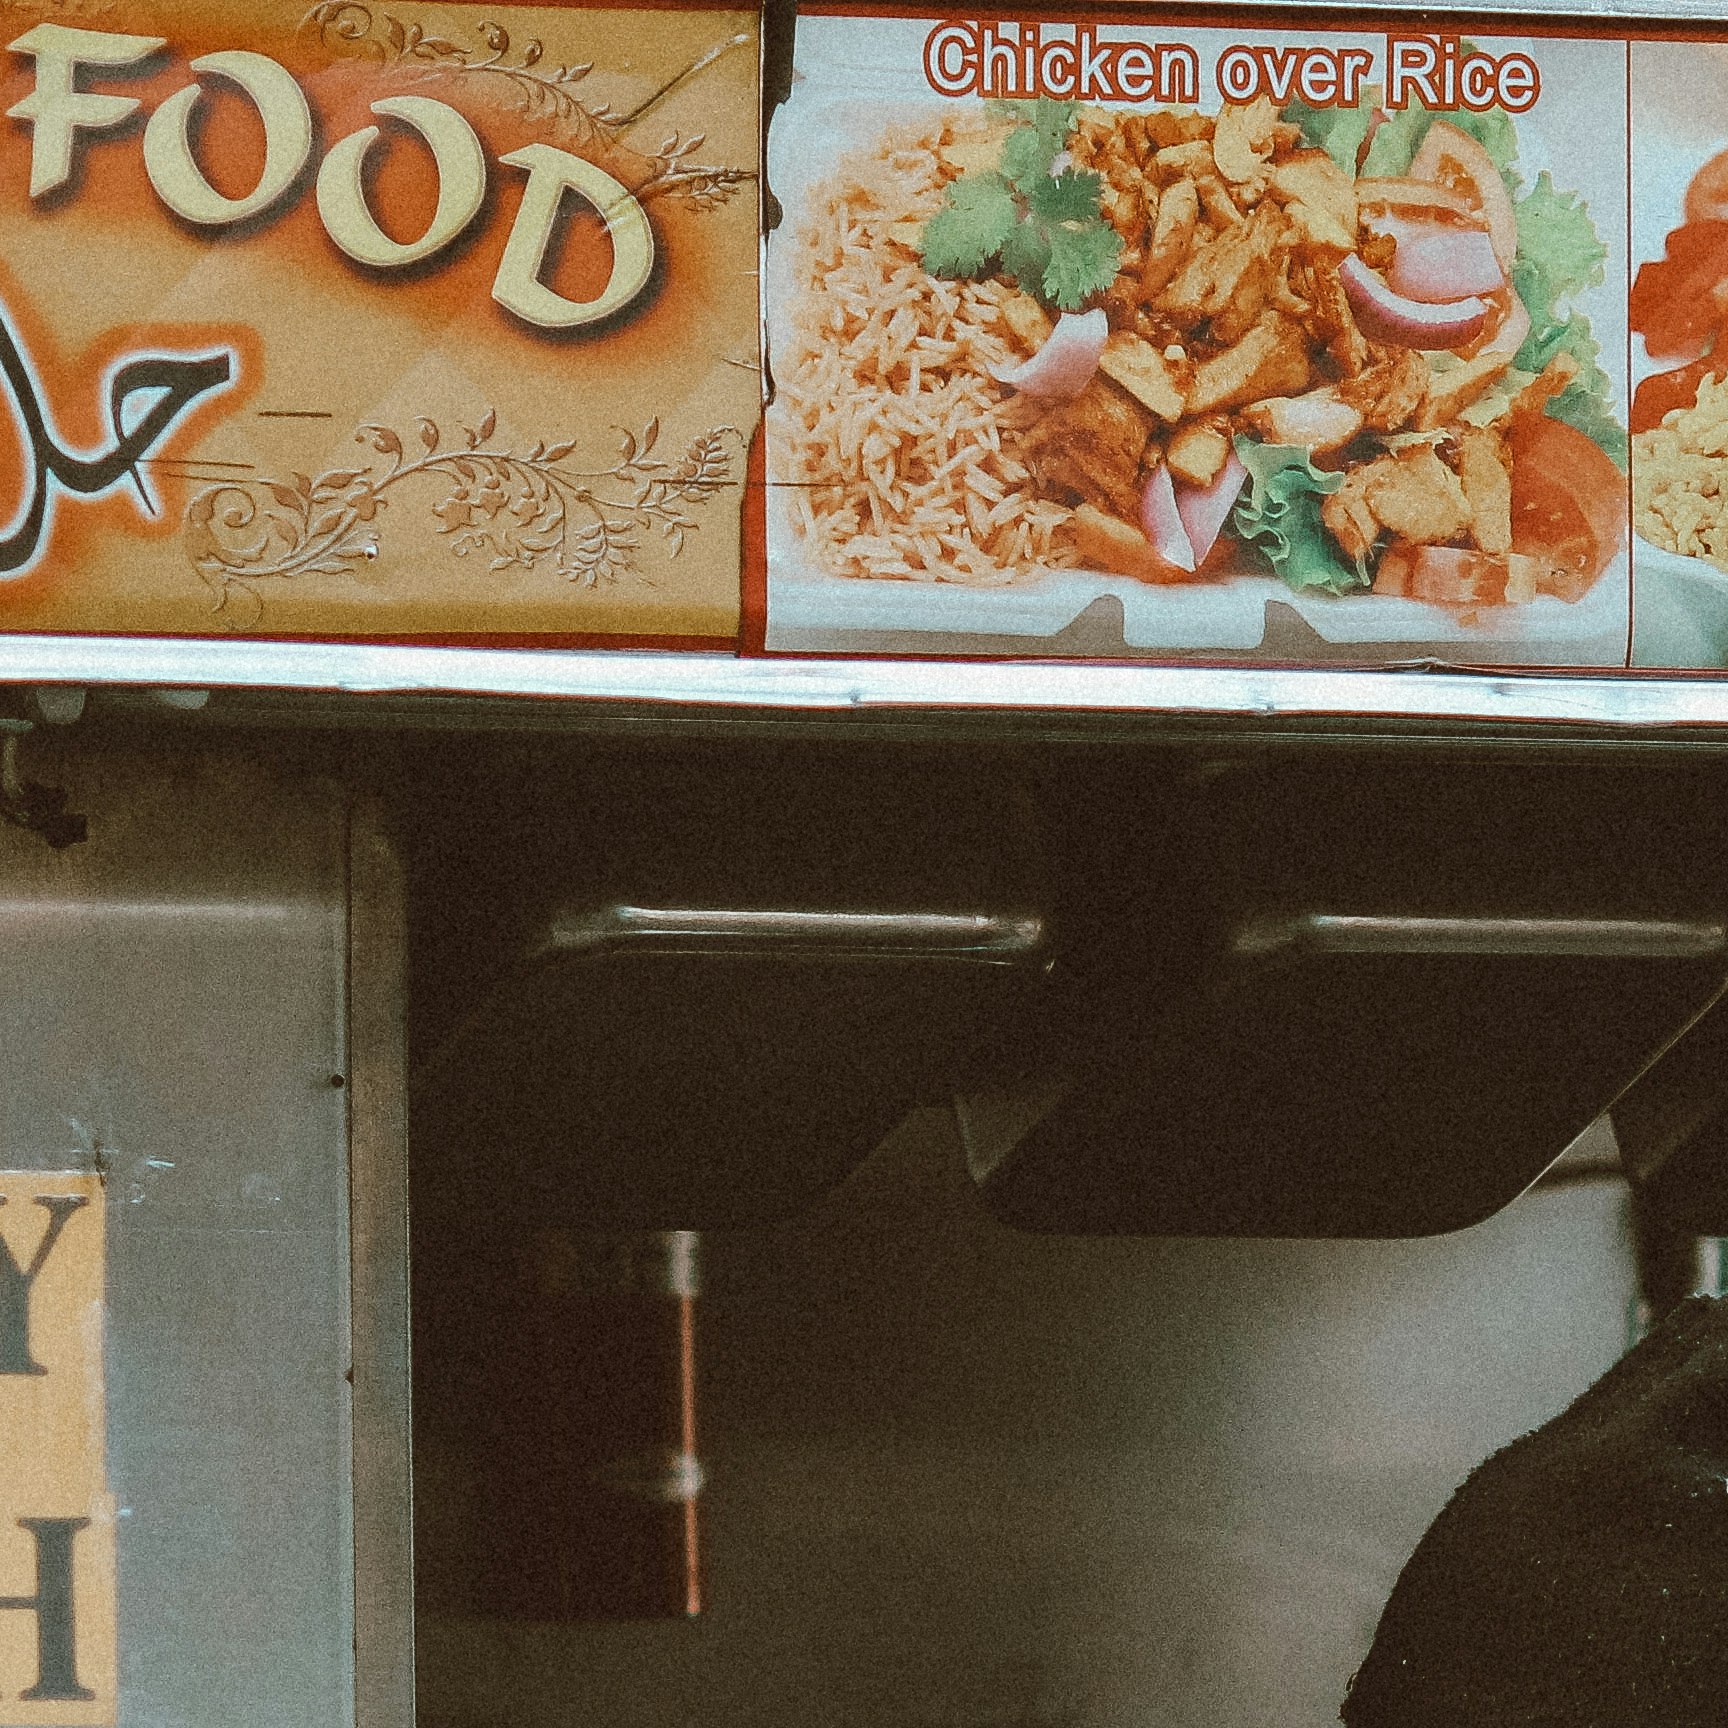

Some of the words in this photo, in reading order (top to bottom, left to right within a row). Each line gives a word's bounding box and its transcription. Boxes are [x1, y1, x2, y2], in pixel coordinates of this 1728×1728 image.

[927, 23, 1196, 99] Chicken
[1220, 47, 1374, 103] over
[1391, 38, 1539, 109] Rice
[6, 14, 659, 330] FOOD
